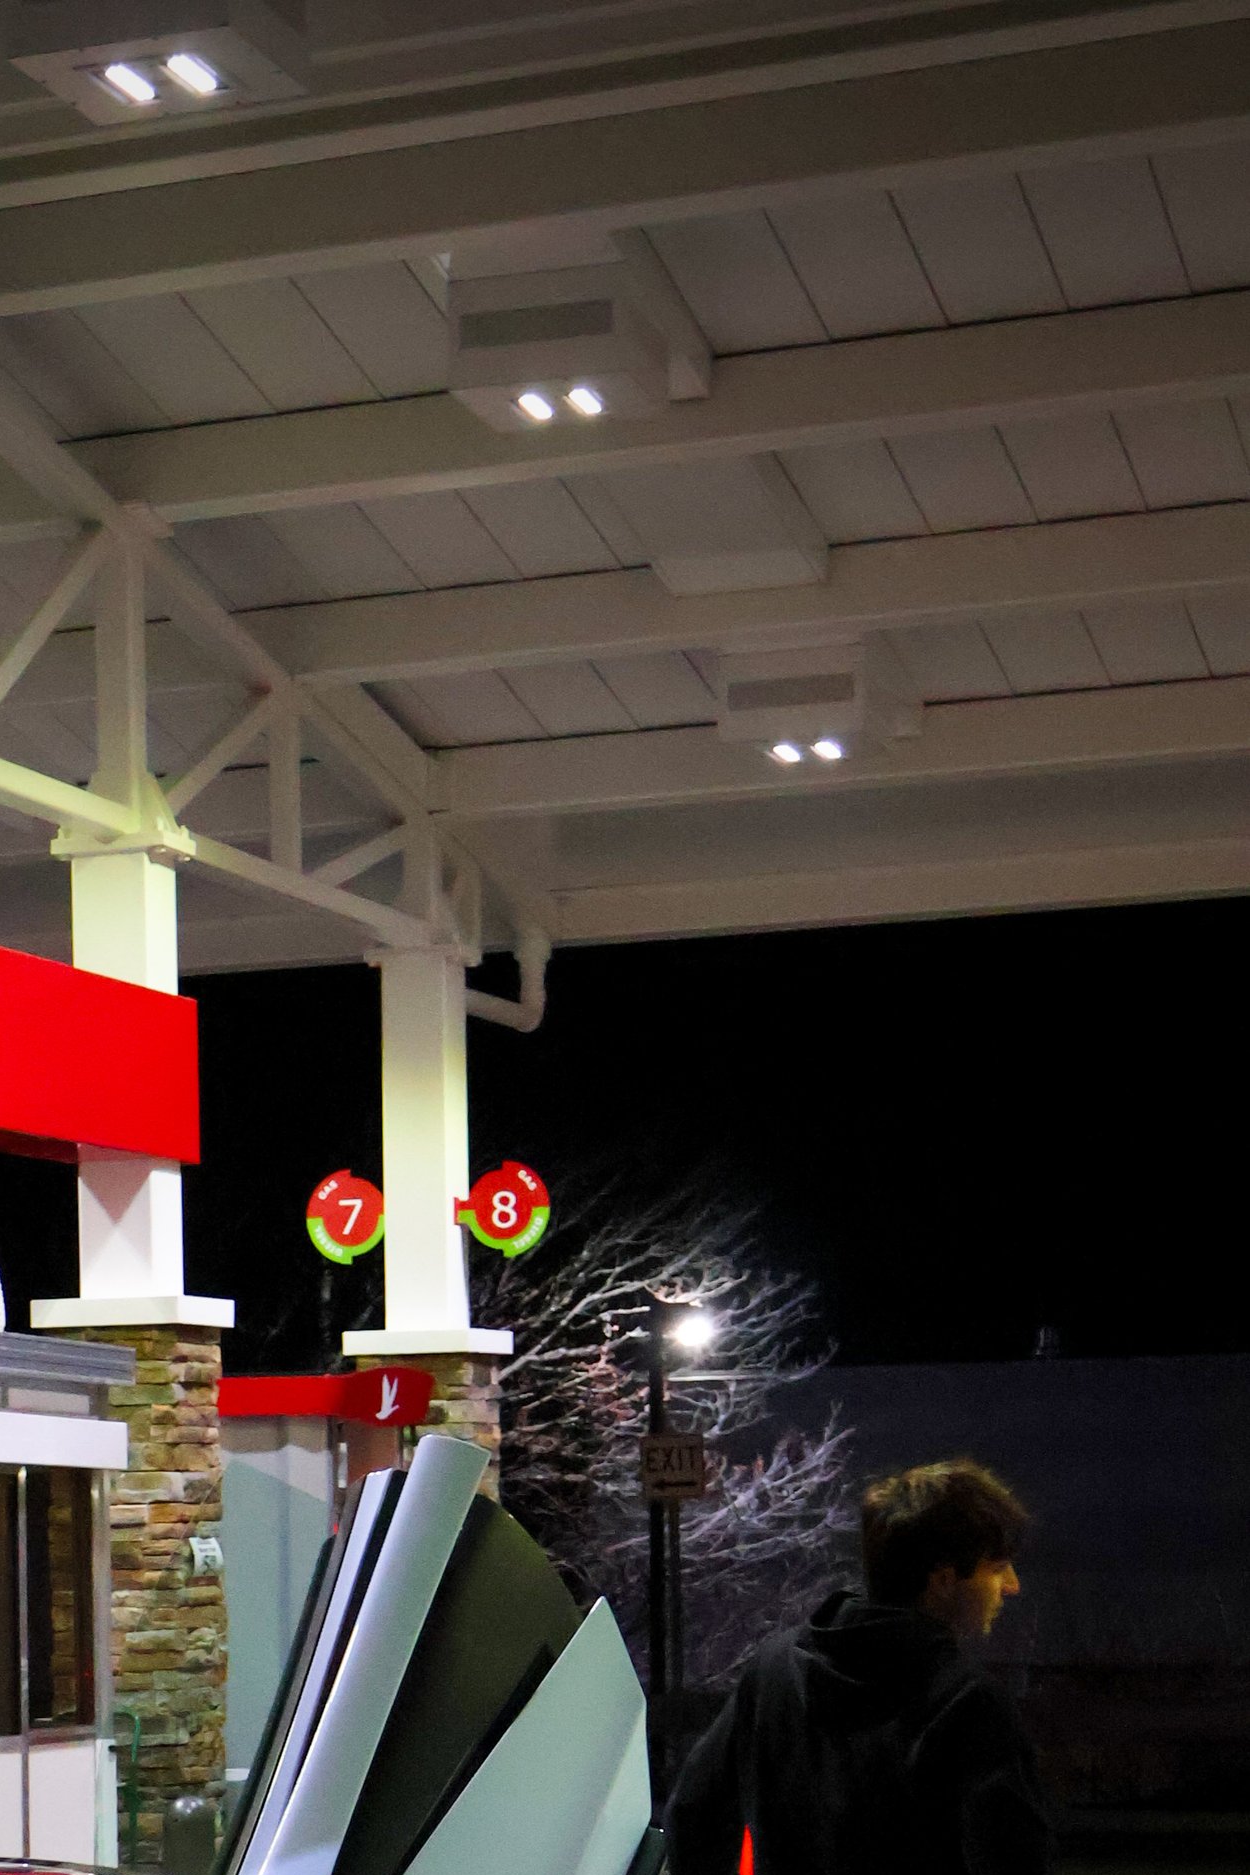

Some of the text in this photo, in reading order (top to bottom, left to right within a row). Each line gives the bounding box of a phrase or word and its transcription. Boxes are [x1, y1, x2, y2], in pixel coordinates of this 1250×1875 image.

[318, 1180, 339, 1200] GAS
[517, 1169, 537, 1191] GAS
[338, 1198, 363, 1235] 7
[492, 1190, 517, 1229] 8
[646, 1446, 697, 1471] EXIT
